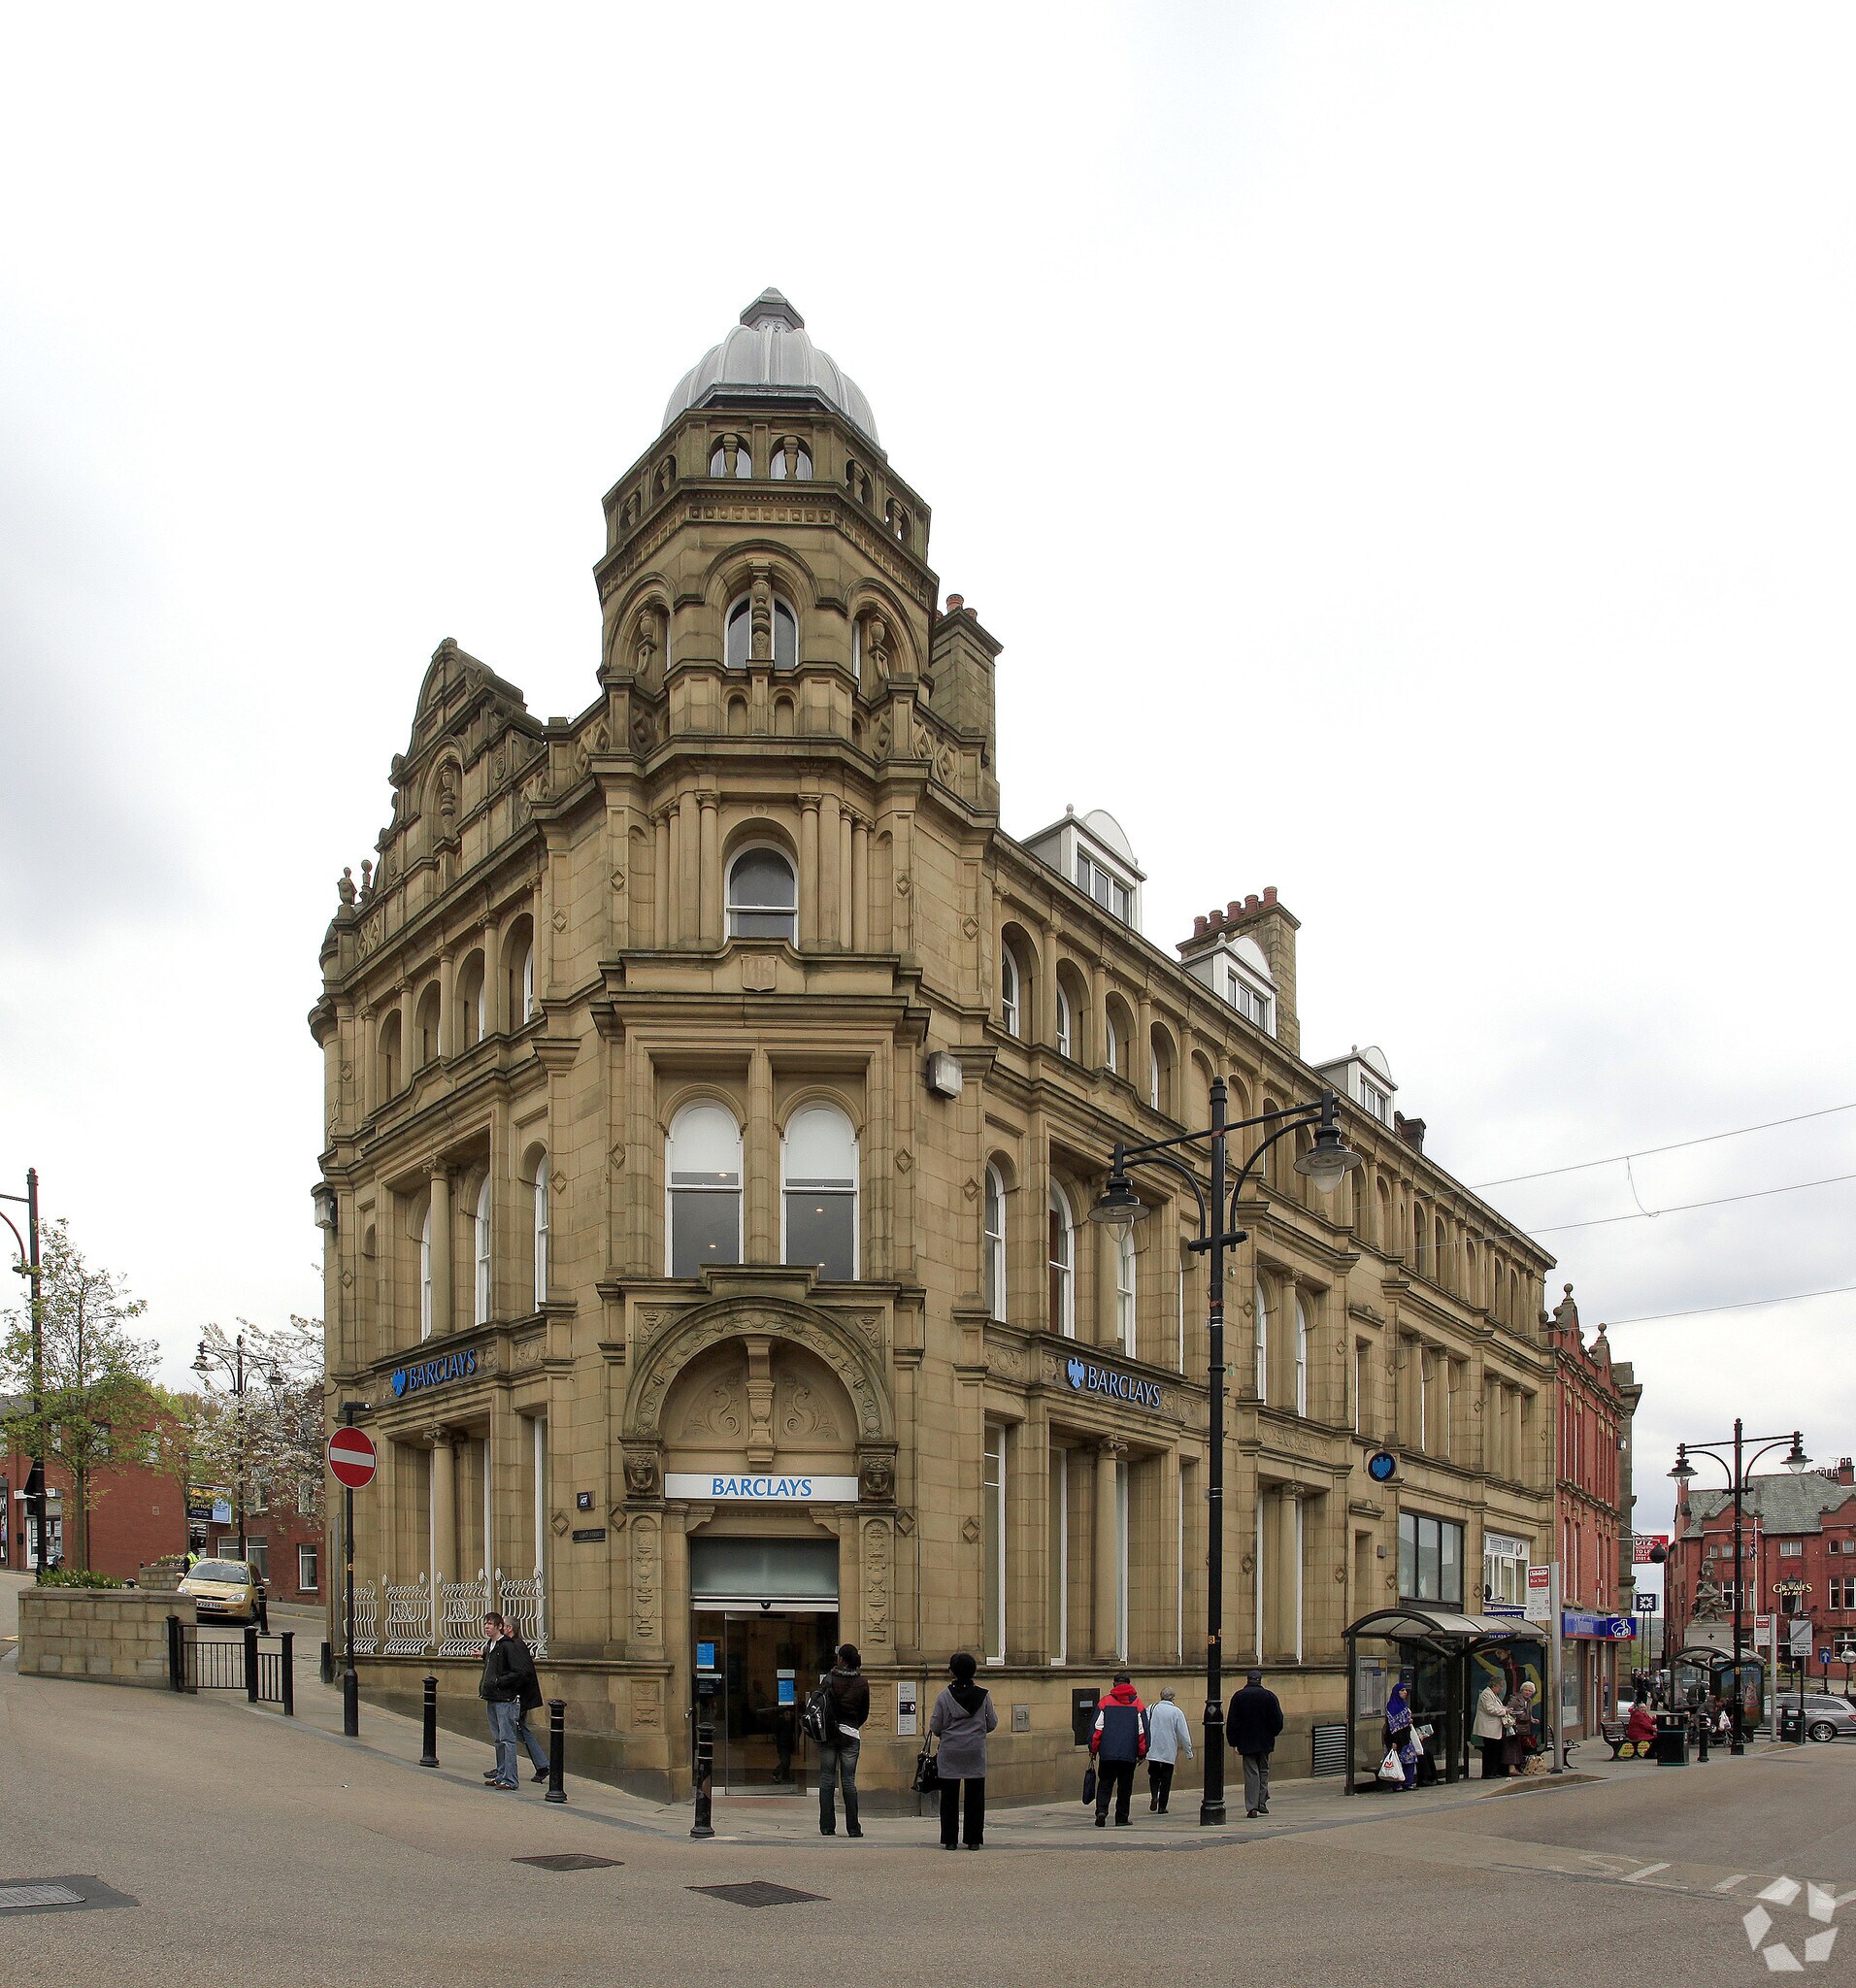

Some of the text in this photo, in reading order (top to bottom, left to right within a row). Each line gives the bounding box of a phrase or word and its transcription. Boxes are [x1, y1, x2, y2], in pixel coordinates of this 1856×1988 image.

[409, 1348, 477, 1390] BARCLAYS
[1087, 1365, 1161, 1408] BARCLAYS
[712, 1478, 812, 1497] BARCLAYS
[1773, 1583, 1812, 1593] GRAVES
